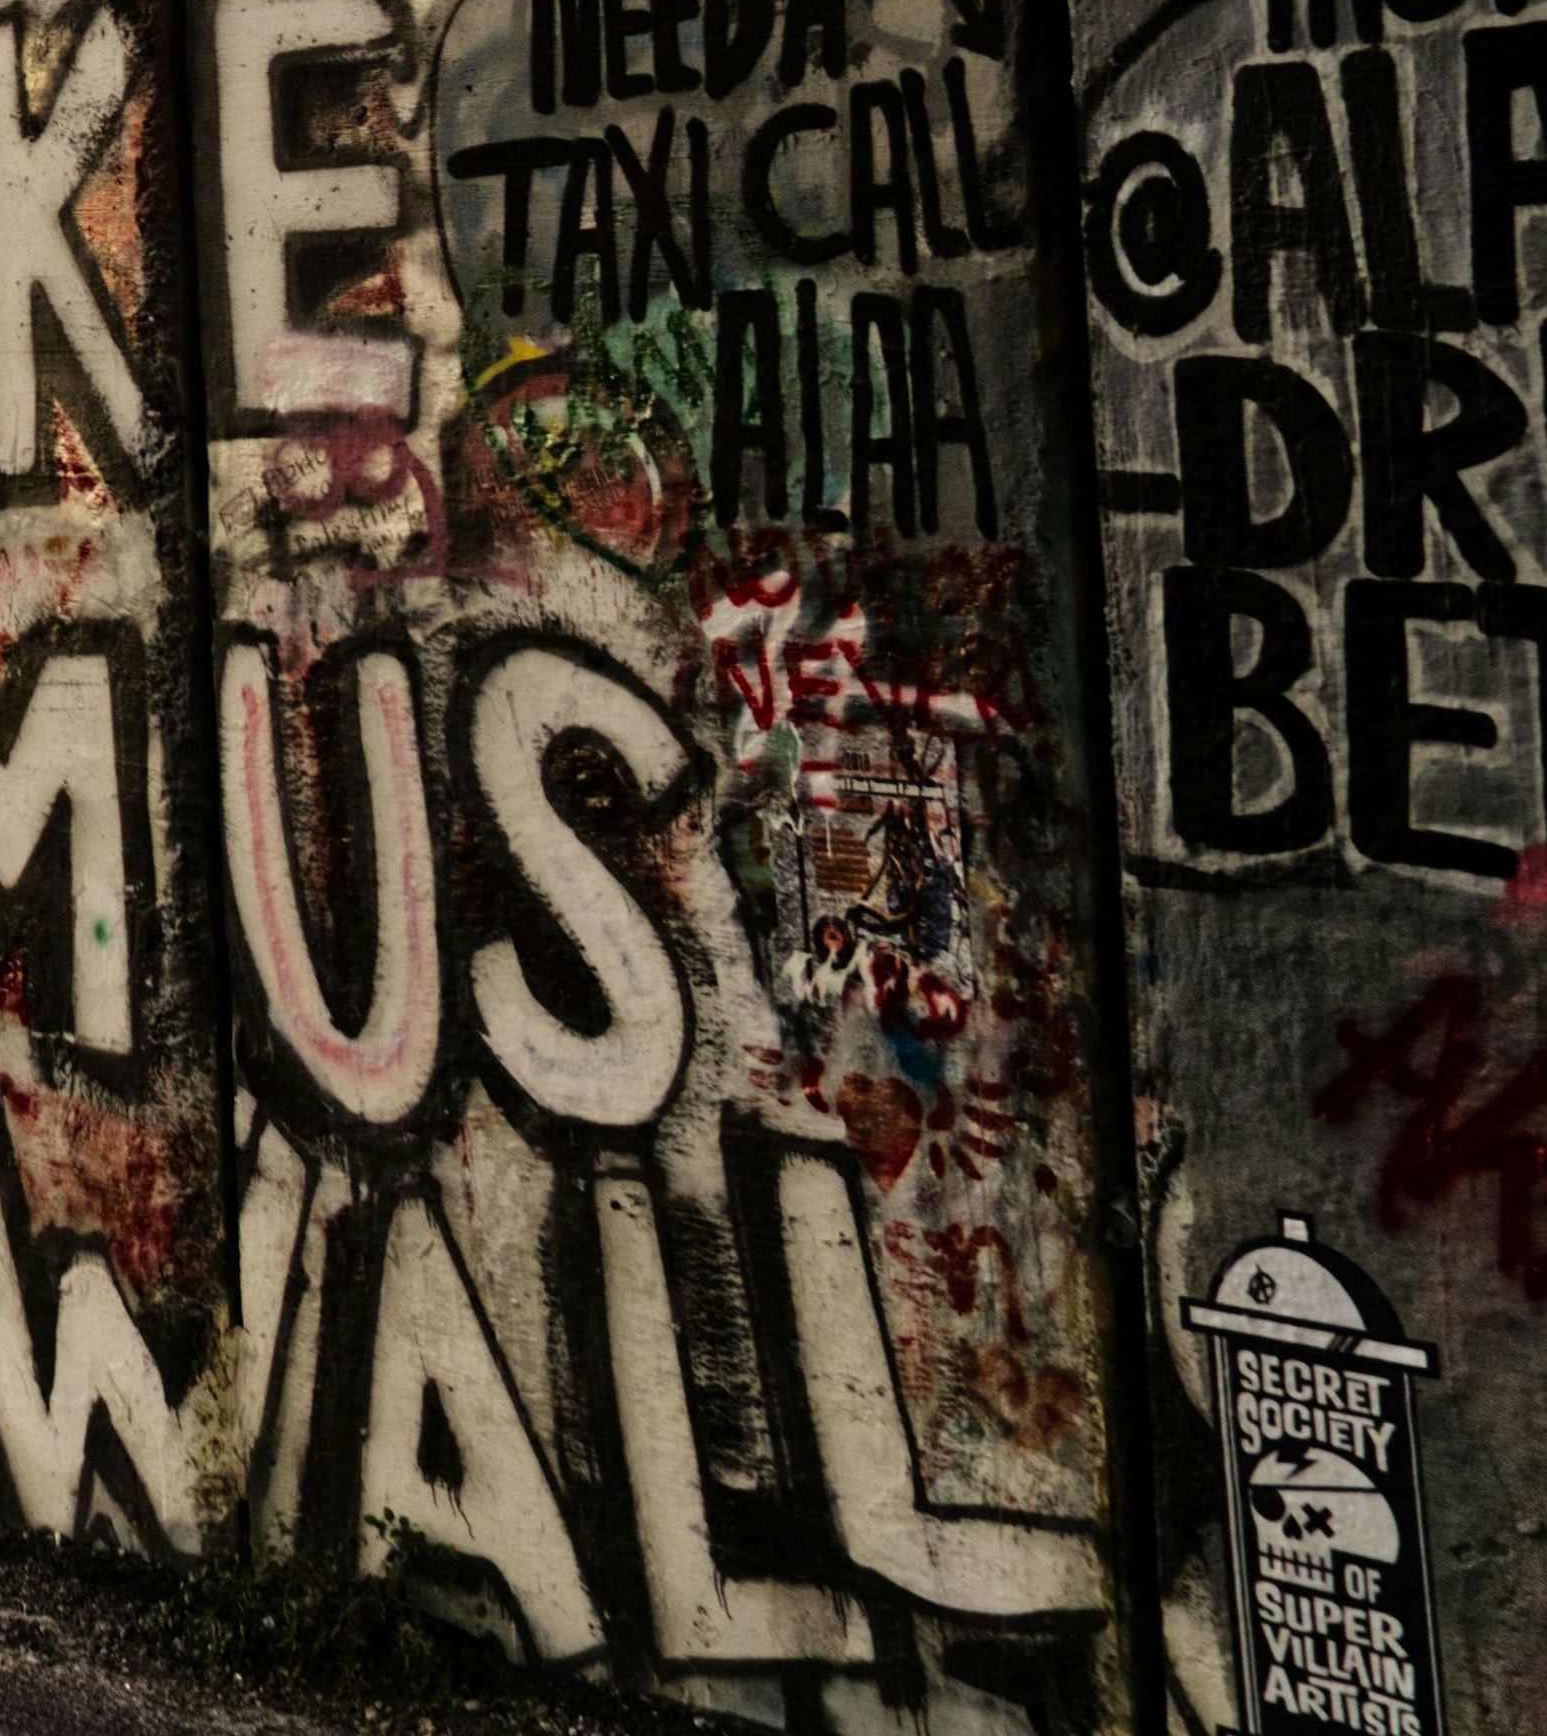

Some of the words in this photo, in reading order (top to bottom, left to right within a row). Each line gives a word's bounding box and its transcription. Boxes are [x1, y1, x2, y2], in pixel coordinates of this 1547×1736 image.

[446, 106, 715, 324] TAXI
[742, 57, 1035, 276] CALL
[1236, 1348, 1392, 1417] SECRET
[1236, 1391, 1396, 1474] SOCIETY
[1253, 1581, 1407, 1658] SUPER
[1344, 1563, 1382, 1605] OF
[1262, 1622, 1416, 1701] VILLAIN
